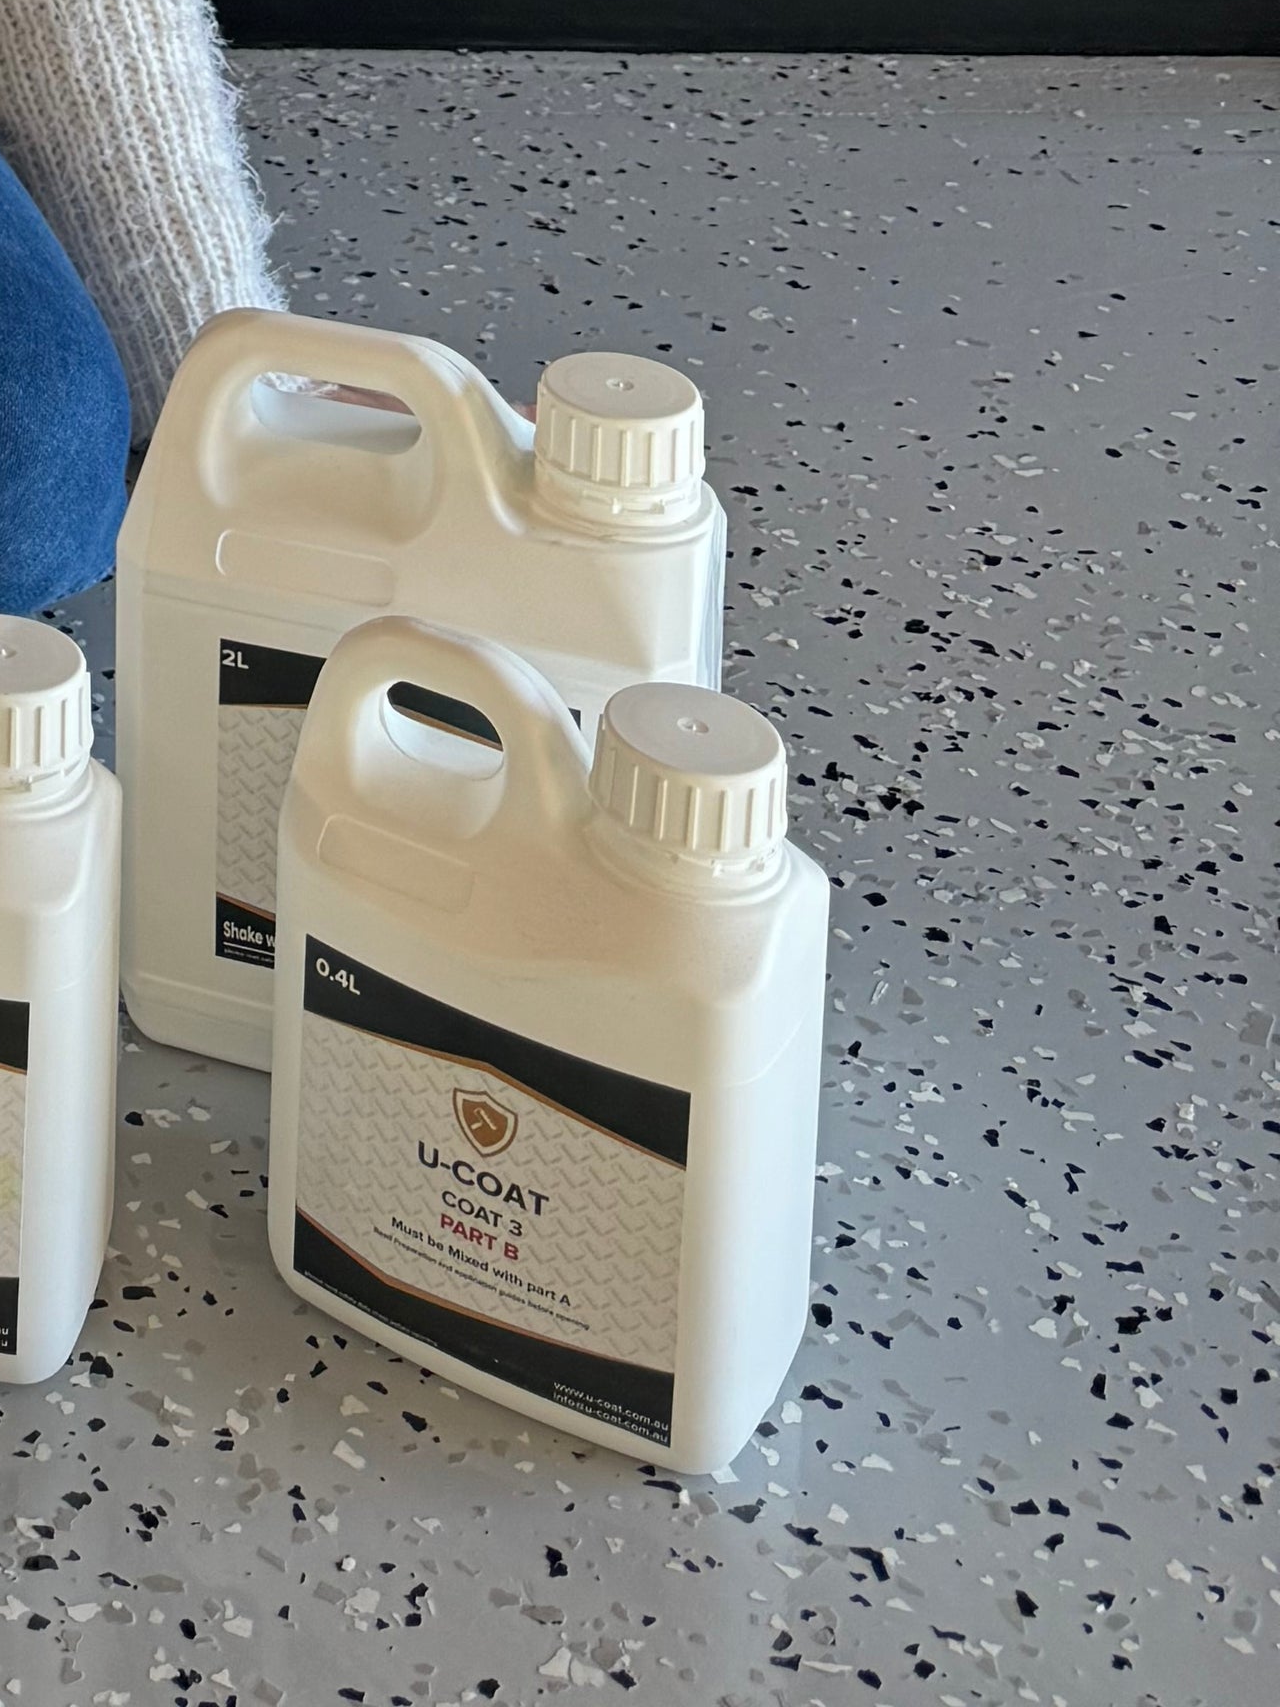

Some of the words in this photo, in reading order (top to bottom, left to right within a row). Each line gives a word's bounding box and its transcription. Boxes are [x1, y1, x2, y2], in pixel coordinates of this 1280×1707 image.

[221, 649, 249, 670] 2L
[223, 920, 264, 945] Shake
[315, 957, 361, 995] 0.4L
[417, 1140, 550, 1216] U-COAT
[440, 1213, 498, 1251] PART
[503, 1242, 519, 1261] B
[441, 1190, 503, 1228] COAT
[508, 1219, 523, 1237] 3
[392, 1216, 424, 1242] Must
[427, 1234, 444, 1251] be
[448, 1245, 489, 1272] Mixed
[492, 1266, 523, 1288] with
[527, 1281, 556, 1301] part
[559, 1294, 571, 1307] A
